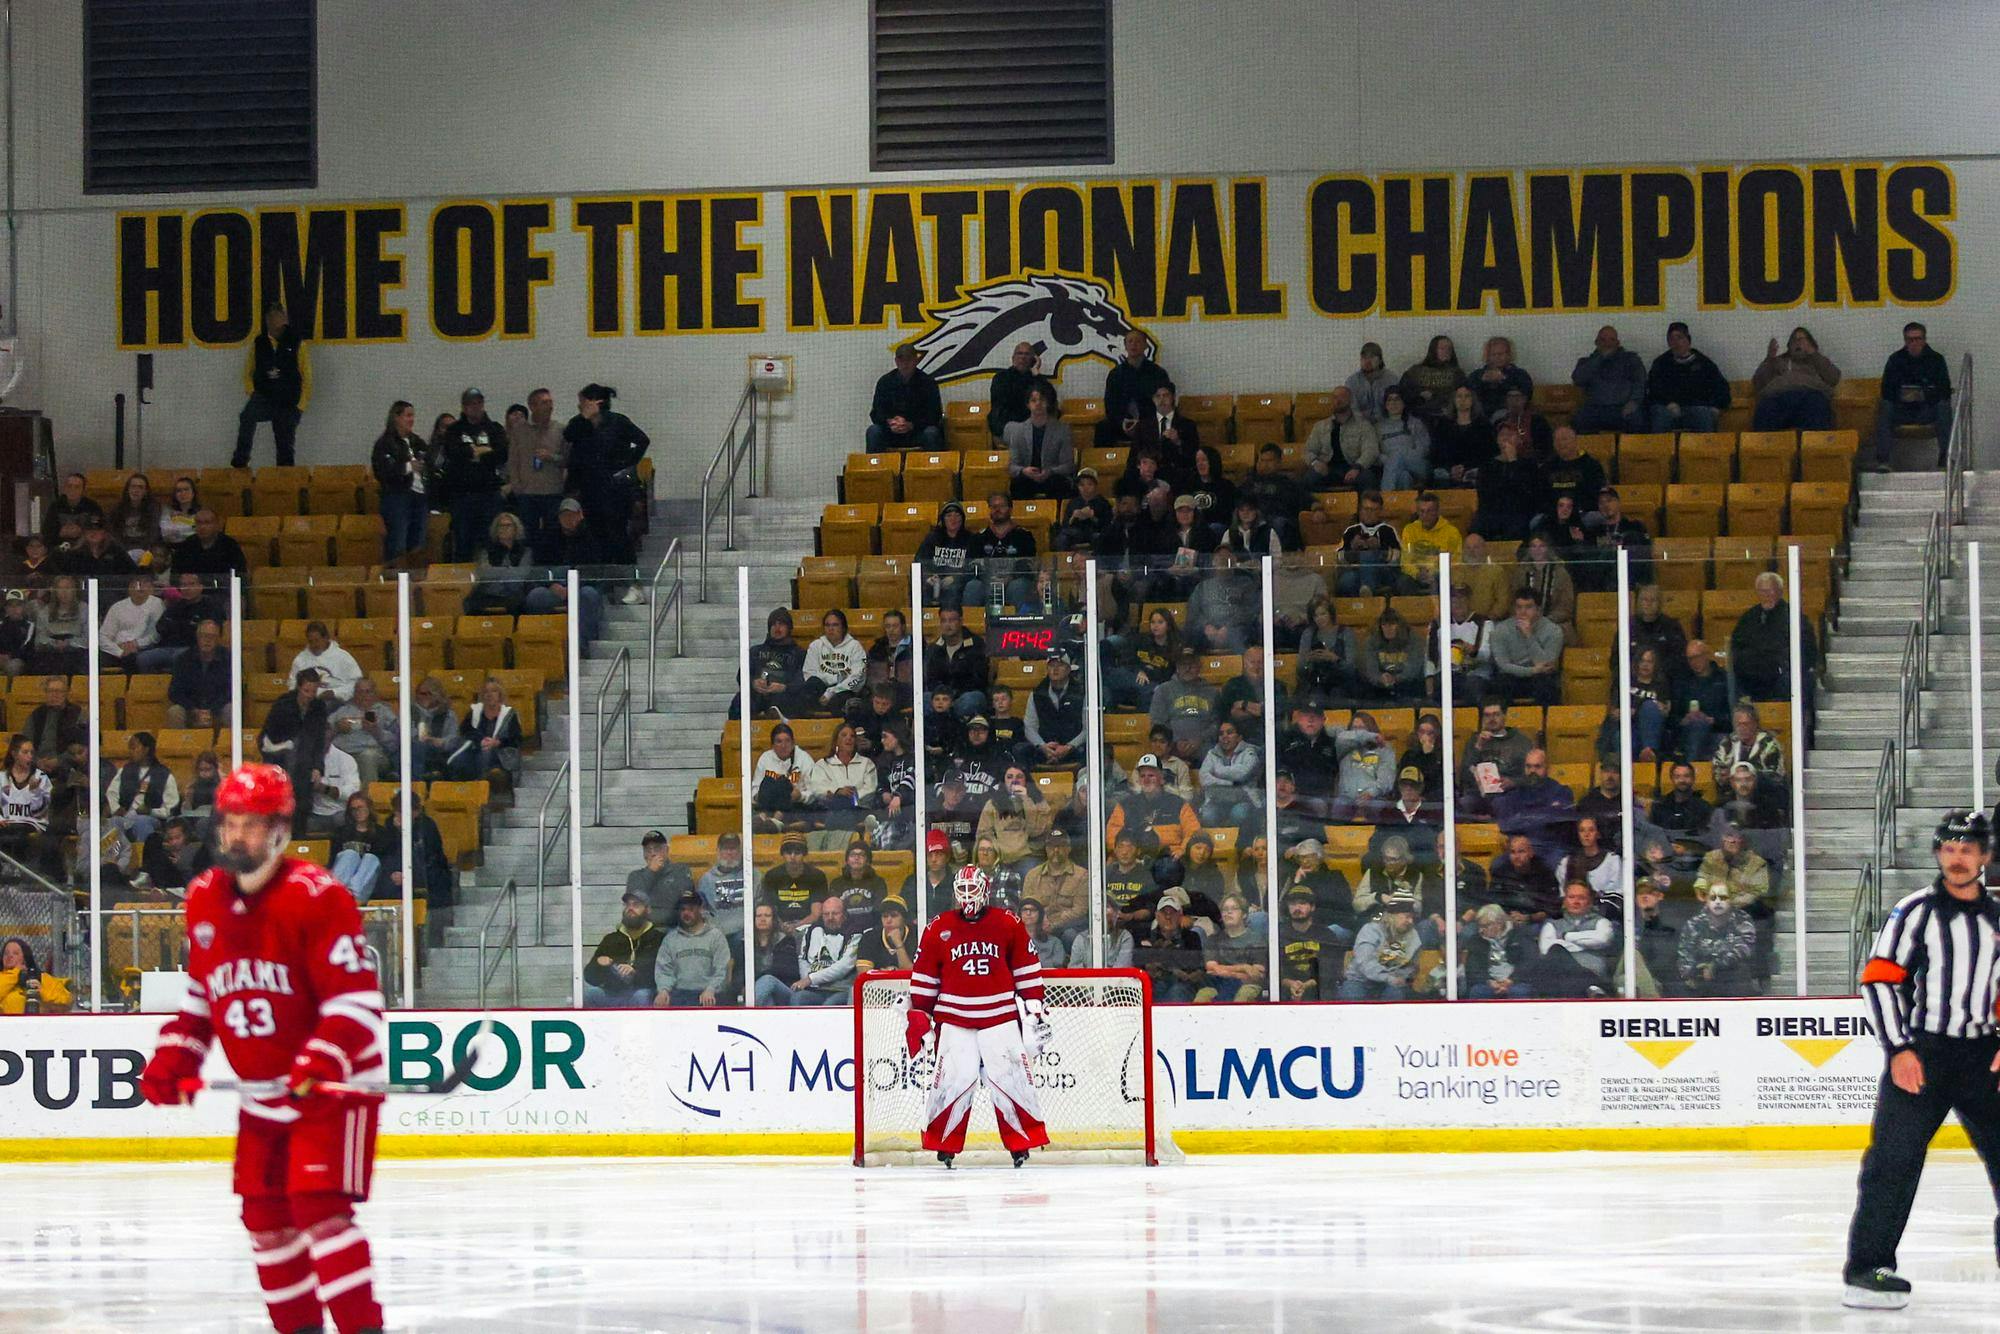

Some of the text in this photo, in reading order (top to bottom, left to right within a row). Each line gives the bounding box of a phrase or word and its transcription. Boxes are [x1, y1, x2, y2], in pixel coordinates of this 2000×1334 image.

[116, 161, 1957, 351] HOME OF THE NATIONAL CHAMPIONS
[1001, 629, 1053, 649] 19:42
[950, 941, 999, 962] MIAMI
[962, 959, 990, 975] 45
[206, 957, 294, 1001] MIAMI
[224, 997, 276, 1038] 43
[1600, 1018, 1720, 1038] BIERLEIN
[388, 1019, 586, 1092] BOR
[1395, 1043, 1518, 1068] You'll love
[1185, 1046, 1365, 1100] LMCU
[1600, 1076, 1720, 1085] DEMOLITION DISMANTLING
[1756, 1075, 1877, 1084] DEMOLITION DISMANTLING
[1398, 1075, 1561, 1104] banking here
[1680, 1085, 1720, 1093] SERVICES
[1837, 1084, 1877, 1092] SERVICES
[1601, 1103, 1676, 1111] ENVIRONMENTAL
[1757, 1102, 1877, 1110] ENVIRONMENTAL SERVICES
[399, 1110, 589, 1127] CREDIT UNION
